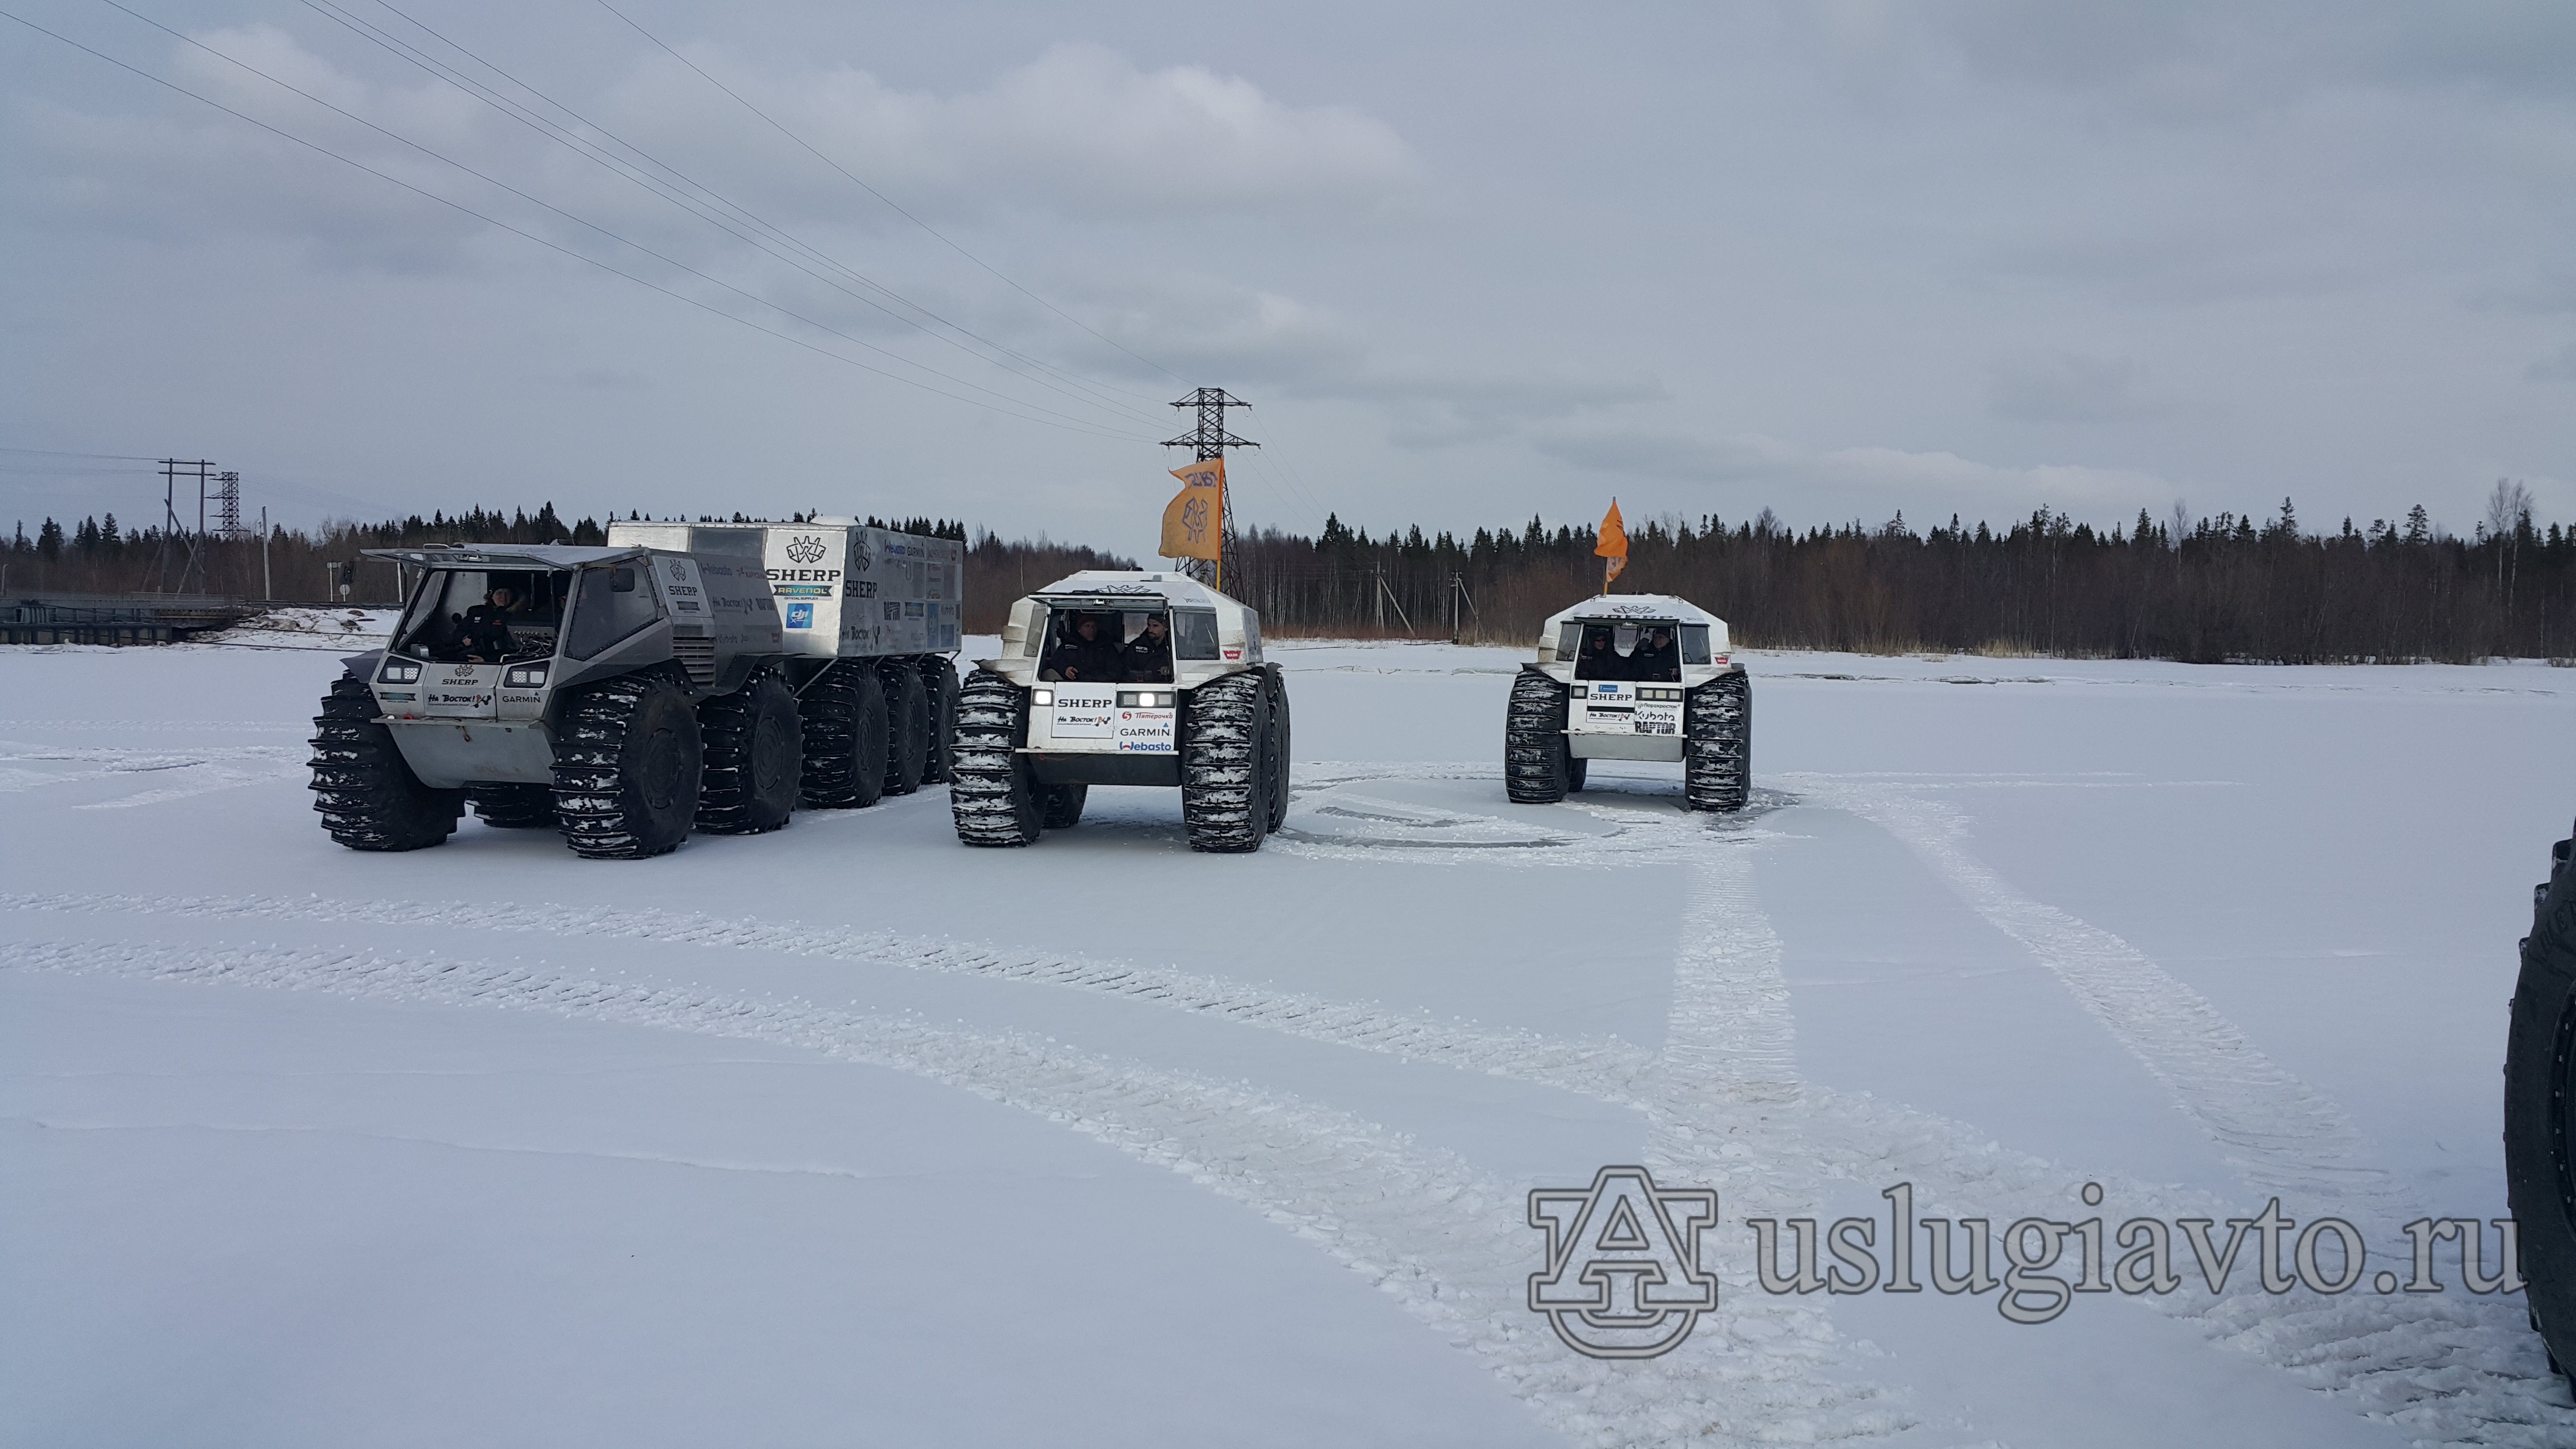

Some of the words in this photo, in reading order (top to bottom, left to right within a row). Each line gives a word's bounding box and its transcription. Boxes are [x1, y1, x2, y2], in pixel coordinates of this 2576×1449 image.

[765, 569, 841, 581] SHERP
[669, 585, 697, 596] SHERP
[845, 580, 877, 598] SHERP
[790, 609, 809, 620] dji
[1058, 699, 1112, 708] SHERP
[1134, 712, 1173, 720] Пятерочка
[1635, 710, 1675, 721] Kubota
[1120, 728, 1170, 737] GARMIN
[1635, 721, 1676, 734] RAPTOR
[1120, 741, 1172, 751] Webasto
